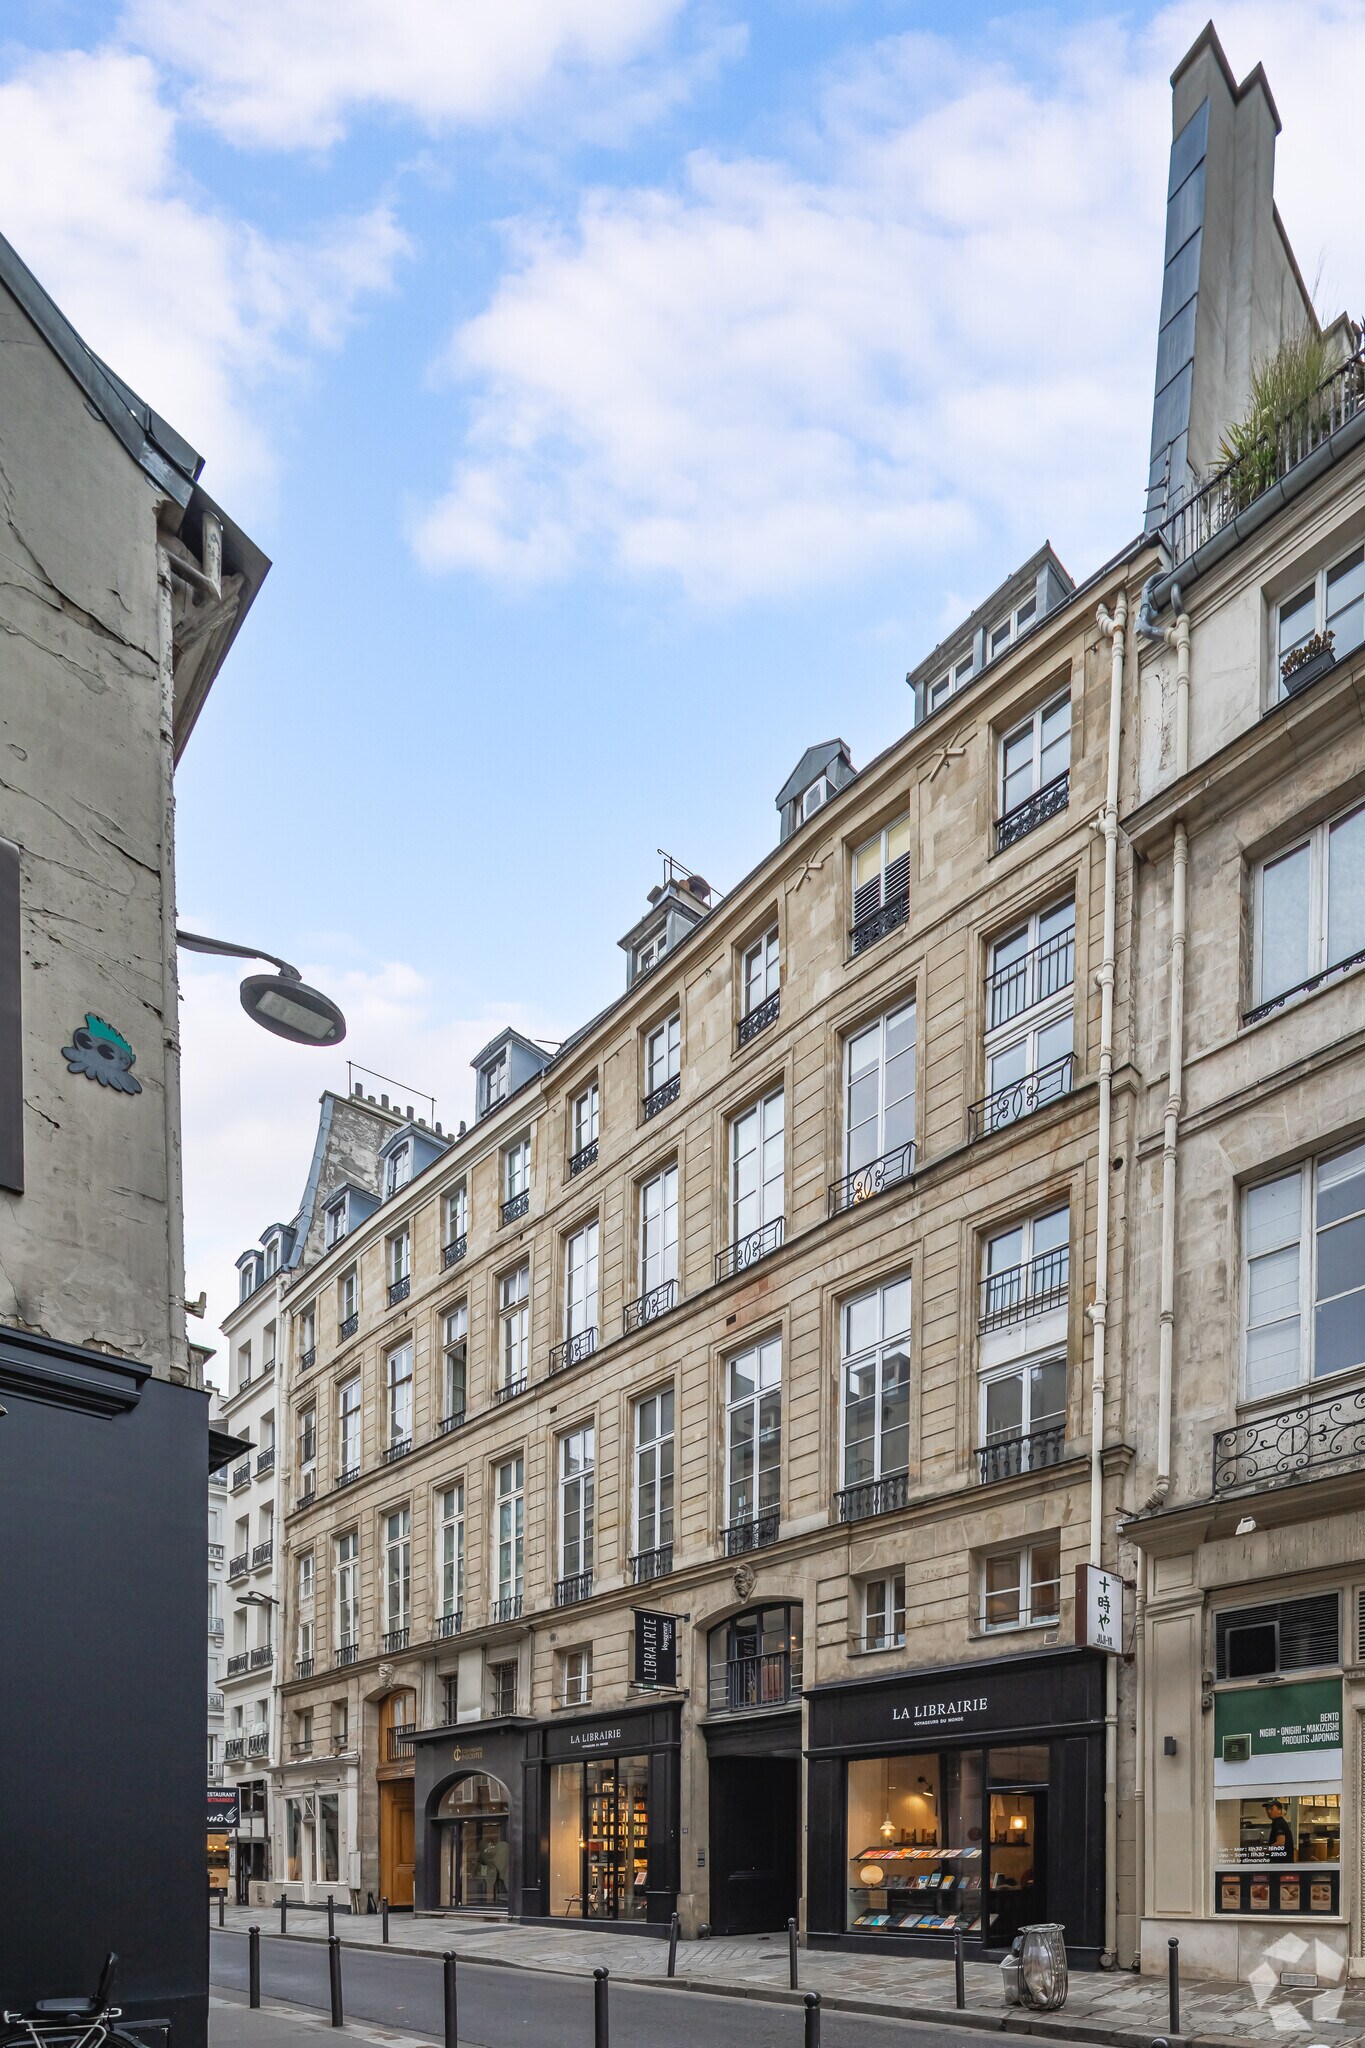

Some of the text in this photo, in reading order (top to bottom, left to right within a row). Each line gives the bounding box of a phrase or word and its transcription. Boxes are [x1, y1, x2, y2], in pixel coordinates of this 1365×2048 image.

[1098, 1576, 1110, 1632] 十時や
[643, 1617, 657, 1680] LIBRAIRIE
[892, 1698, 988, 1720] LA LIBRAIRIE
[1320, 1711, 1340, 1722] BENTO
[570, 1729, 621, 1744] LA LIBRAIRIE
[1259, 1728, 1276, 1738] NIGIRI
[1280, 1725, 1302, 1736] ONIGIRI
[1306, 1722, 1340, 1734] MAKIZUSHI
[1282, 1732, 1339, 1745] PRODUITS JAPONAIS
